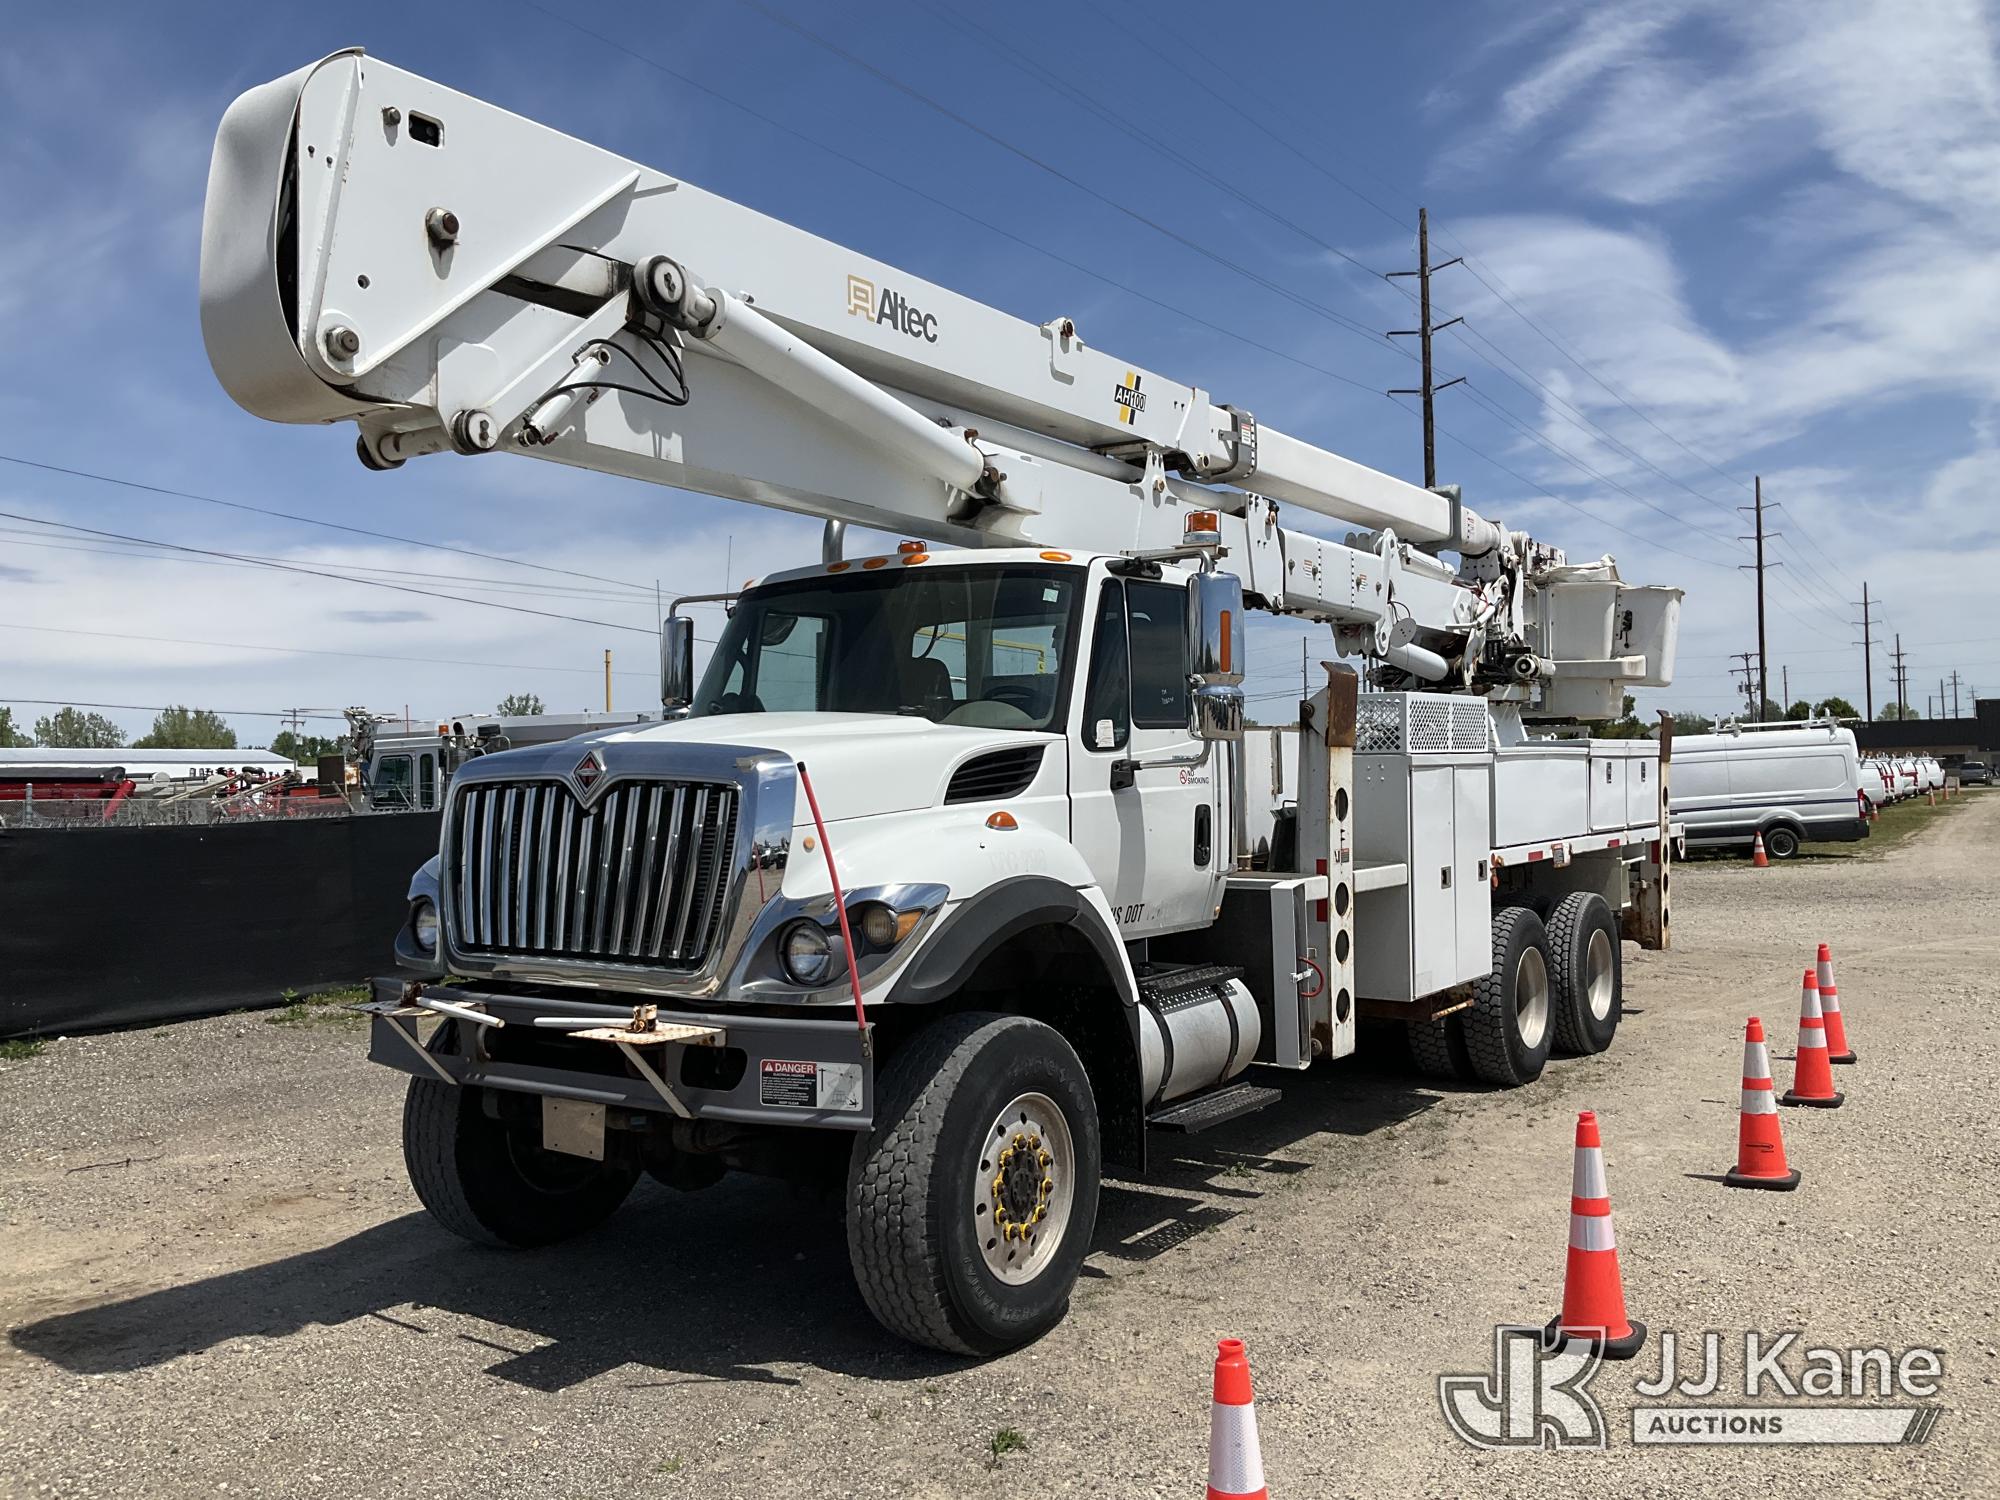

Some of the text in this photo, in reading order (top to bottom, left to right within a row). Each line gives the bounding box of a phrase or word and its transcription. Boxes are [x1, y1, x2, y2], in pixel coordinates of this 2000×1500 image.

[876, 287, 938, 343] Altec
[1115, 386, 1146, 410] AH100
[1124, 903, 1146, 924] DOT
[775, 1062, 813, 1073] DANGER
